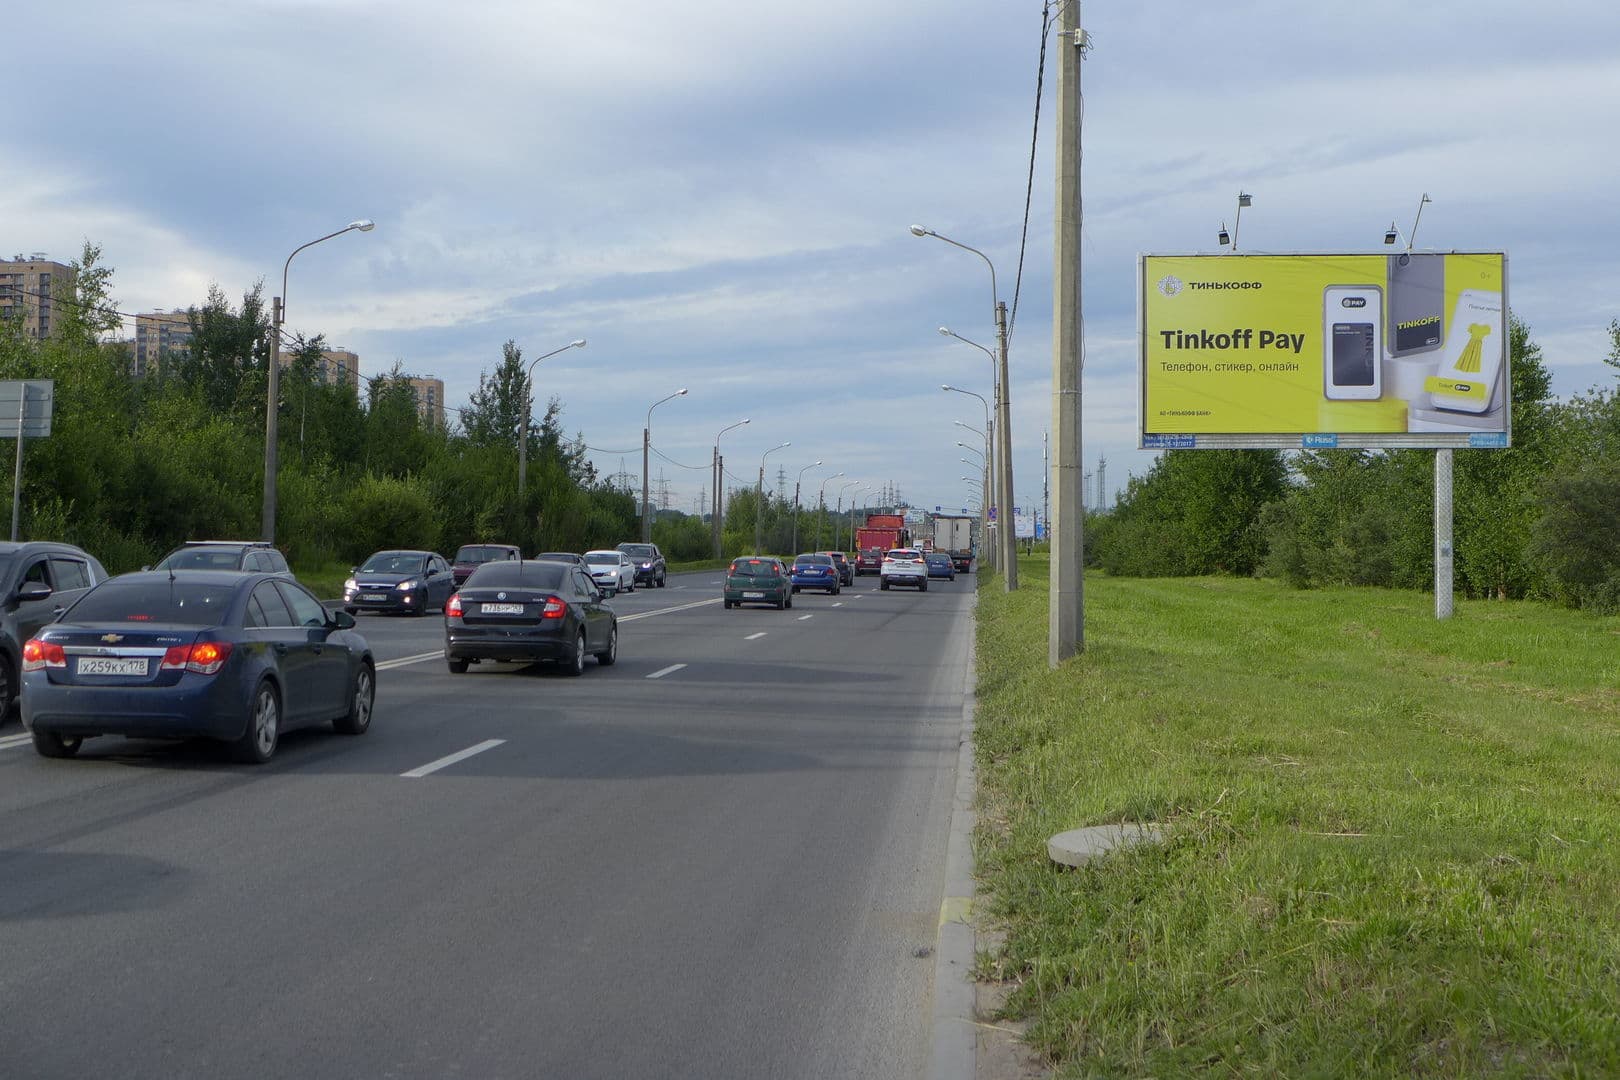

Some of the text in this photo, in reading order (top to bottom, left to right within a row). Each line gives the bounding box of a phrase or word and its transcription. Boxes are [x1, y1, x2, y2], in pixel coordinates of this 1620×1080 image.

[1189, 281, 1262, 290] ТИНЬКОФФ
[1397, 316, 1441, 329] TINKOFF
[1160, 329, 1305, 353] Tinkoff Pay
[1161, 361, 1299, 373] Телефон, стикер, онлайн
